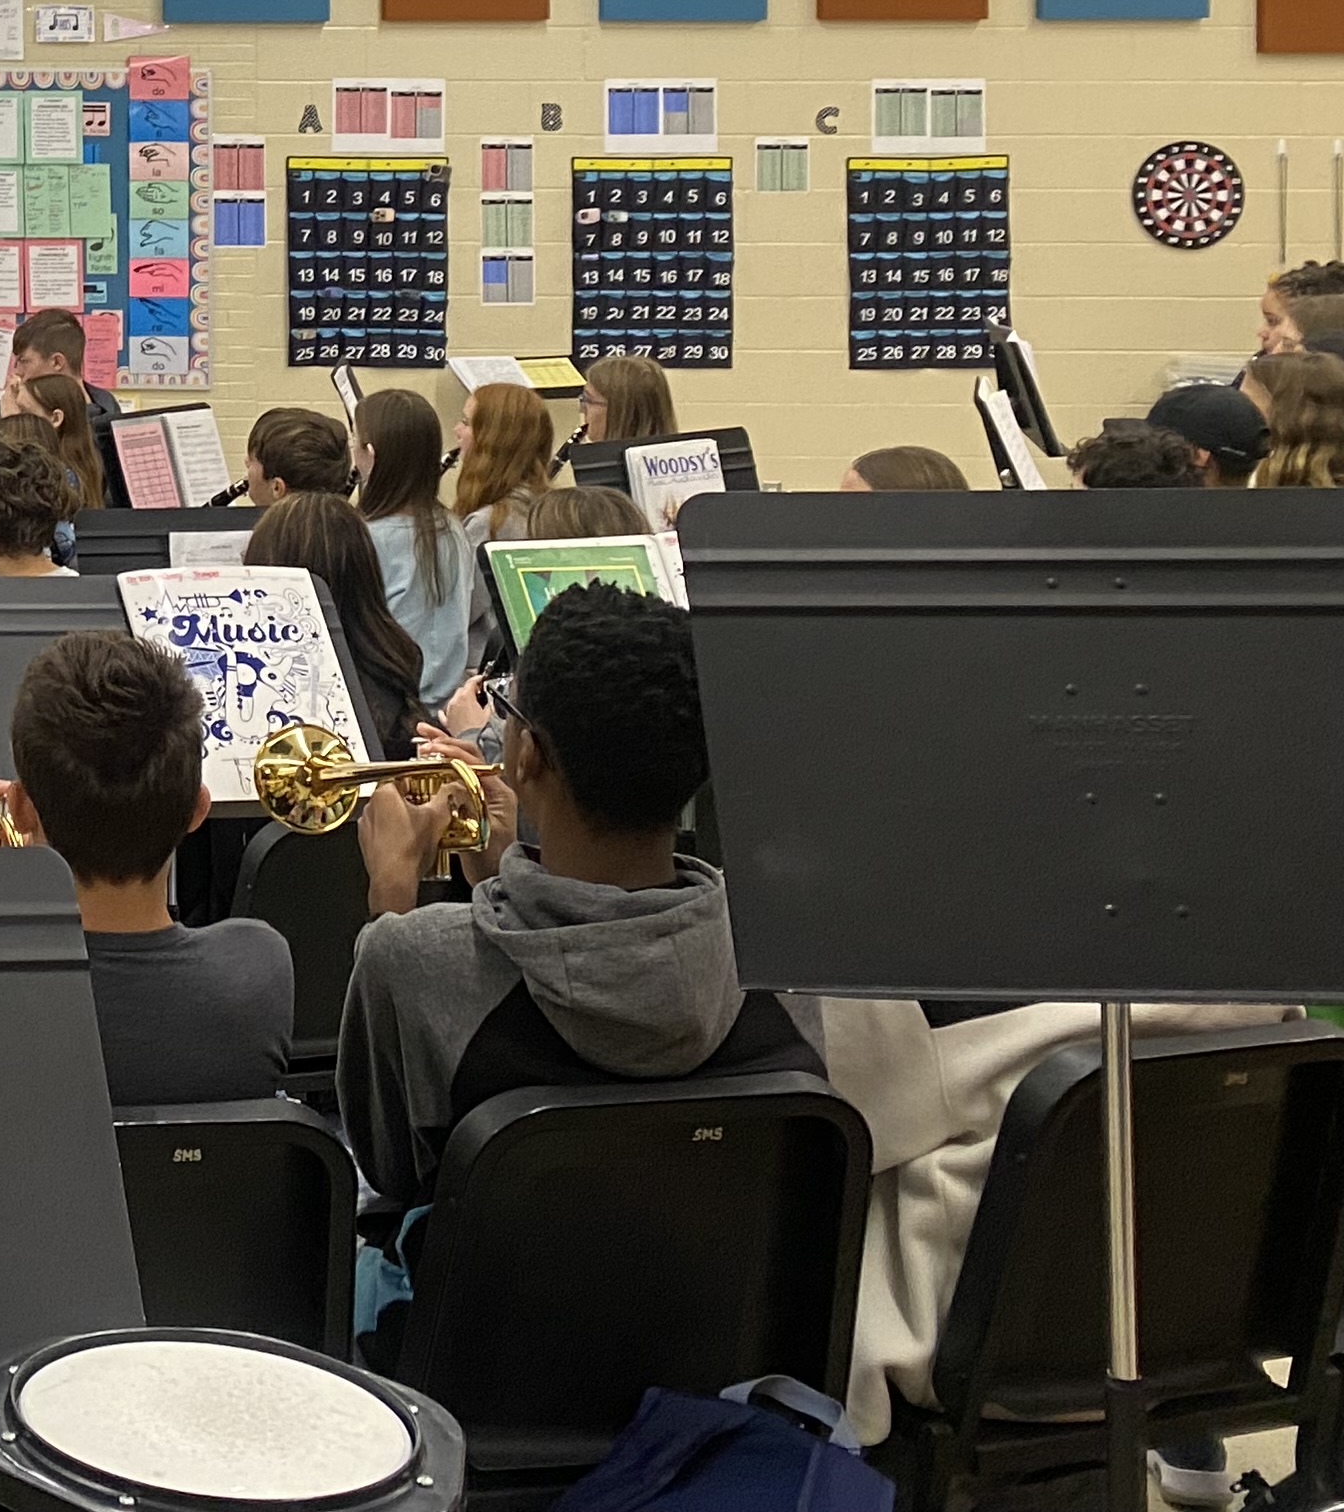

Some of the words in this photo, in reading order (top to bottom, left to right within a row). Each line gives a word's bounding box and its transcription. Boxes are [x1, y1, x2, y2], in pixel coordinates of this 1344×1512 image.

[152, 87, 165, 97] do
[298, 104, 323, 133] A
[541, 103, 562, 131] B
[815, 106, 839, 134] C
[302, 190, 311, 204] 1
[326, 189, 337, 204] 2
[352, 191, 363, 205] 3
[379, 190, 391, 204] 4
[404, 190, 416, 205] 5
[431, 194, 441, 206] 6
[586, 190, 596, 203] 1
[610, 188, 622, 203] 2
[636, 190, 648, 204] 3
[663, 190, 674, 204] 4
[687, 188, 699, 203] 5
[716, 192, 726, 205] 6
[300, 228, 311, 243] 7
[326, 229, 337, 244] 8
[353, 230, 365, 244] 9
[375, 232, 393, 246] 10
[401, 230, 417, 244] 11
[427, 231, 443, 244] 12
[585, 233, 596, 247] 7
[611, 232, 623, 247] 8
[636, 230, 649, 245] 9
[658, 229, 677, 244] 10
[686, 229, 702, 244] 11
[712, 230, 729, 243] 12
[297, 268, 315, 283] 13
[321, 267, 340, 282] 14
[347, 268, 366, 283] 15
[375, 268, 393, 283] 16
[399, 268, 418, 282] 17
[427, 271, 444, 284] 18
[581, 270, 599, 285] 13
[606, 268, 624, 282] 14
[633, 268, 651, 283] 15
[660, 269, 678, 284] 16
[686, 268, 704, 282] 17
[713, 273, 730, 286] 18
[298, 306, 316, 321] 19
[321, 307, 342, 321] 20
[347, 306, 366, 321] 21
[371, 306, 393, 321] 22
[397, 307, 419, 322] 23
[424, 310, 444, 323] 24
[580, 306, 598, 320] 19
[606, 307, 625, 321] 20
[631, 305, 650, 320] 21
[655, 305, 677, 320] 22
[682, 306, 703, 321] 23
[708, 307, 728, 320] 24
[295, 346, 315, 361] 25
[319, 344, 339, 358] 26
[343, 345, 366, 360] 27
[370, 343, 391, 358] 28
[396, 343, 418, 359] 29
[424, 348, 444, 361] 30
[579, 343, 600, 359] 25
[606, 345, 625, 358] 26
[633, 345, 652, 358] 27
[656, 345, 677, 360] 28
[682, 344, 704, 359] 29
[709, 345, 728, 359] 30
[152, 361, 165, 370] do
[642, 447, 720, 477] WOODSY'S
[168, 614, 305, 648] Music
[692, 1126, 723, 1141] SMS
[172, 1148, 202, 1162] SMS
